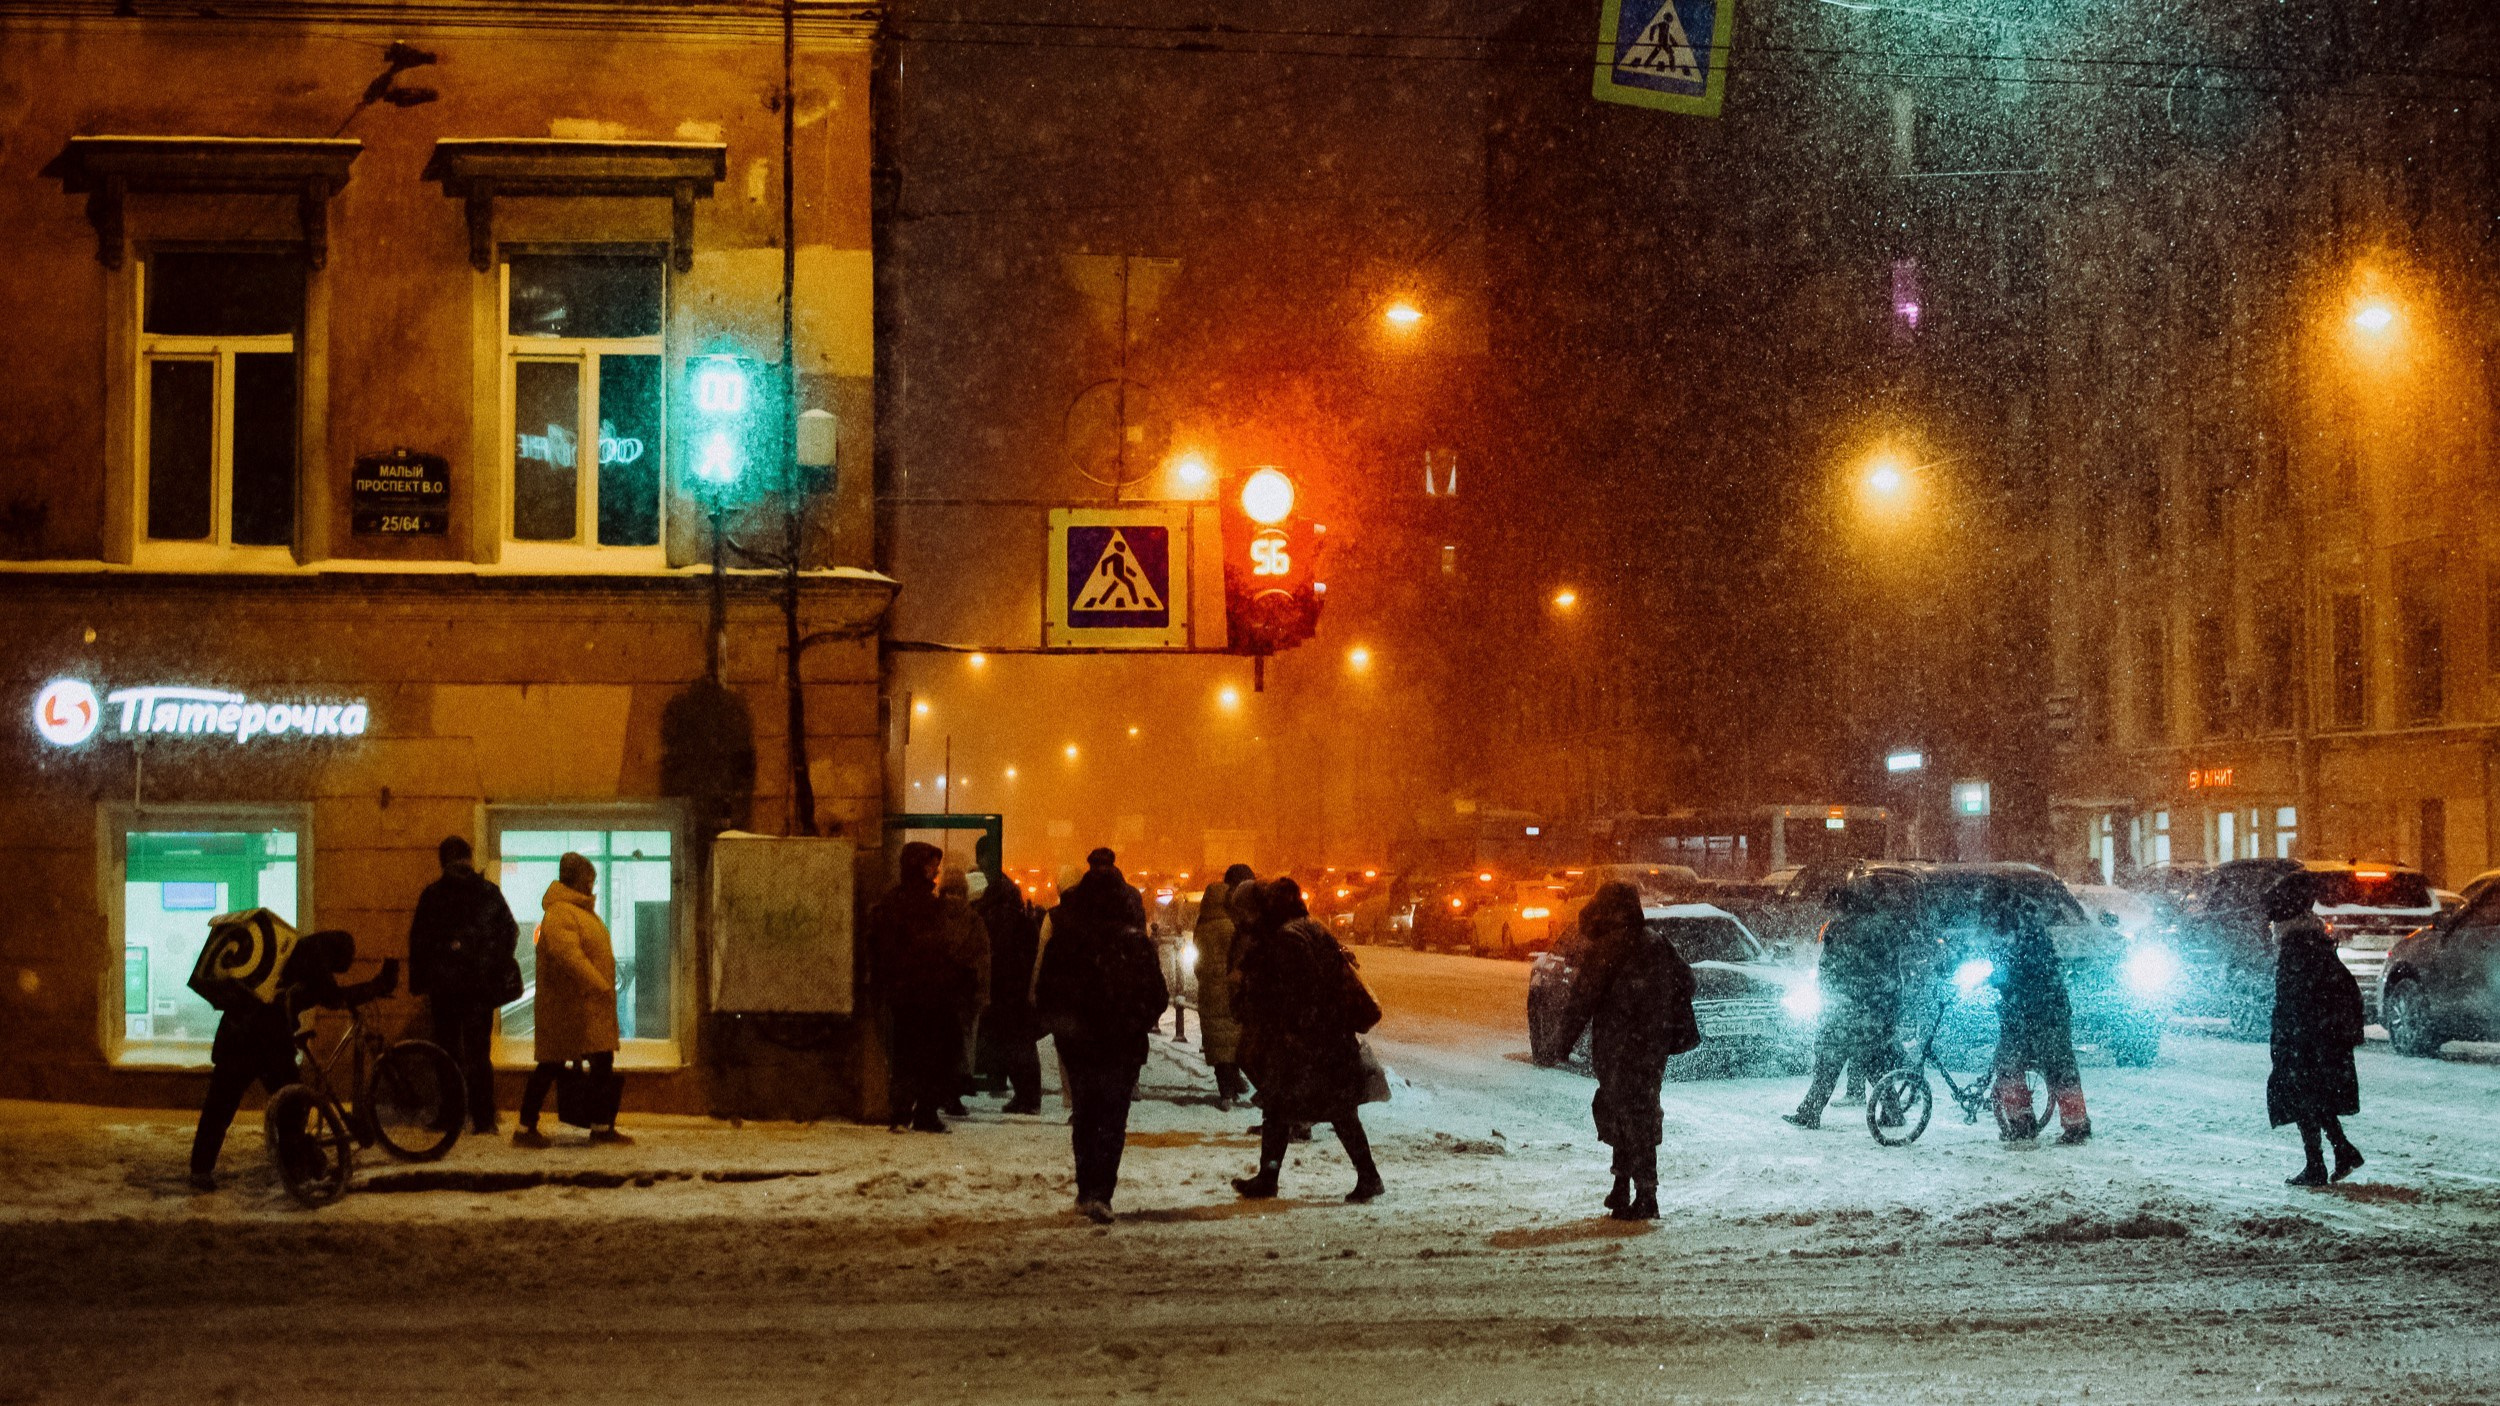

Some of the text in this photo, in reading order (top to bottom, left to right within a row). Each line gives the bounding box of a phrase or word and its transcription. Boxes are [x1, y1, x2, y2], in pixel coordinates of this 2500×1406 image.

[380, 464, 424, 478] МАЛЫЙ
[356, 480, 446, 493] ПРОСПЕКТ В.О.
[381, 516, 420, 531] 25/64
[1250, 539, 1291, 575] 56
[108, 686, 367, 744] Пятёрочка
